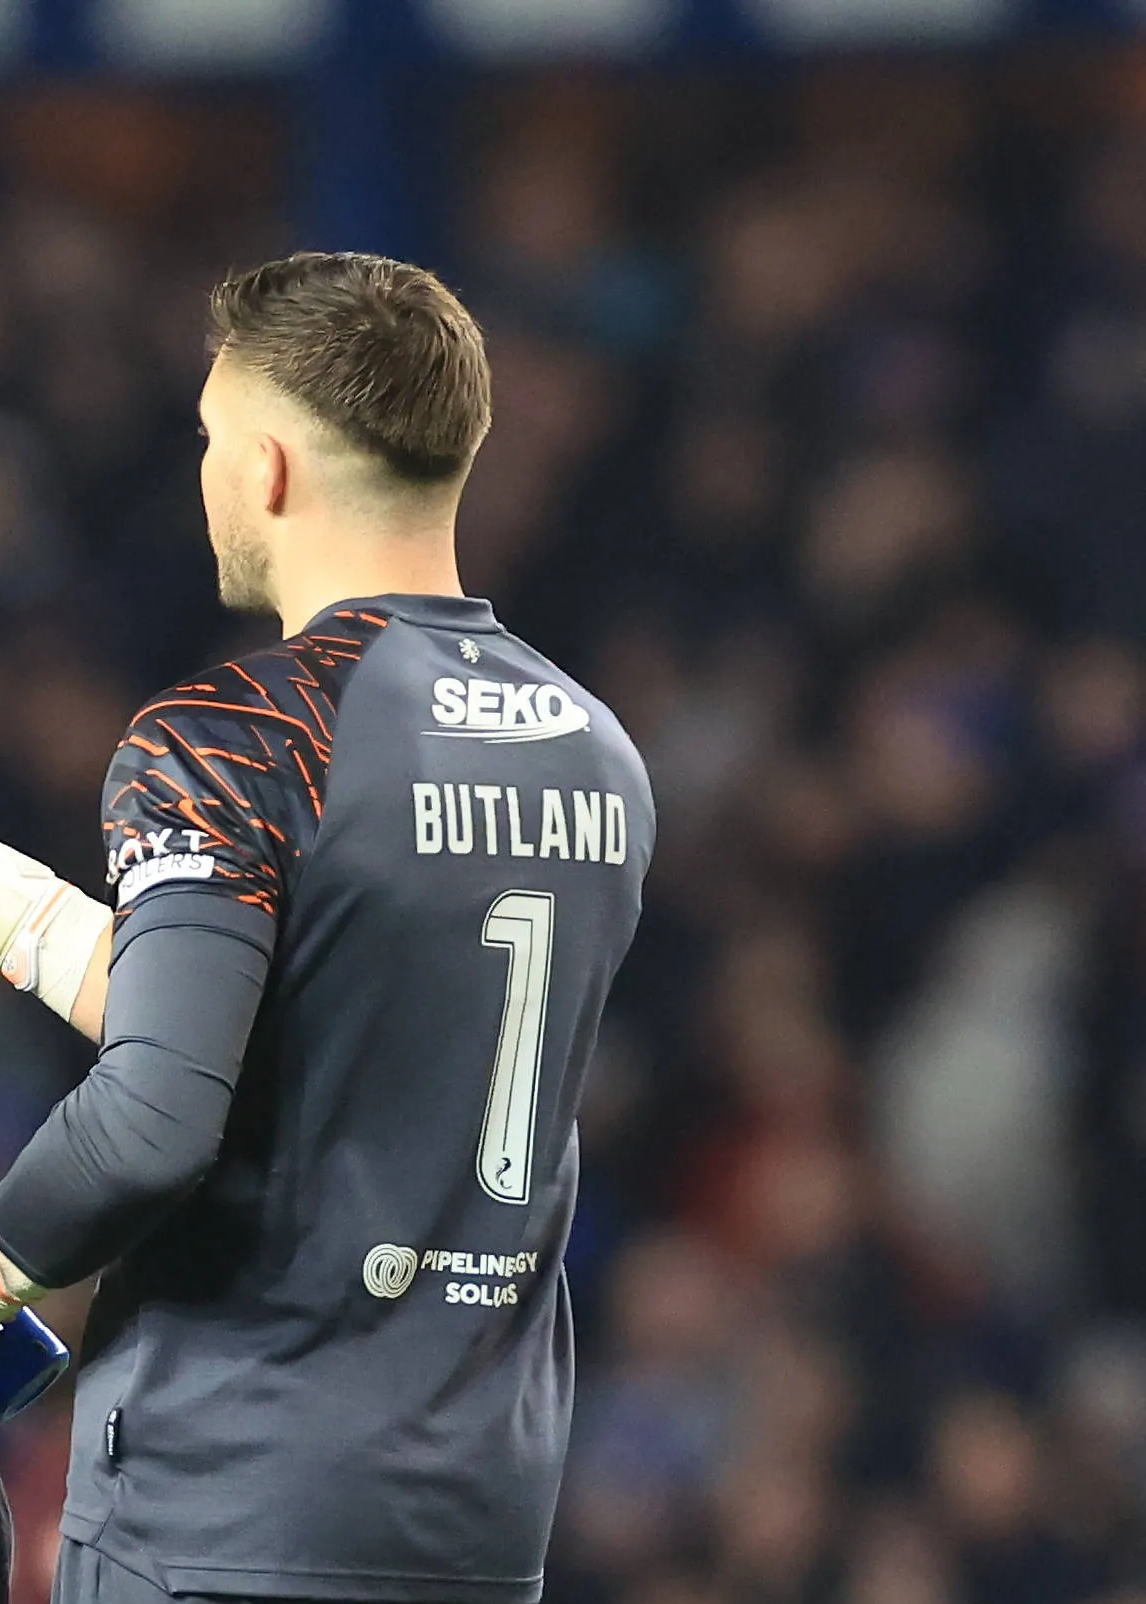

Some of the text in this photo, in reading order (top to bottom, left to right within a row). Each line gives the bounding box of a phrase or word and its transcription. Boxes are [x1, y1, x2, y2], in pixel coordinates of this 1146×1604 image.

[431, 677, 574, 725] SEKO
[412, 782, 627, 865] BUTLAND
[476, 889, 554, 1204] 1
